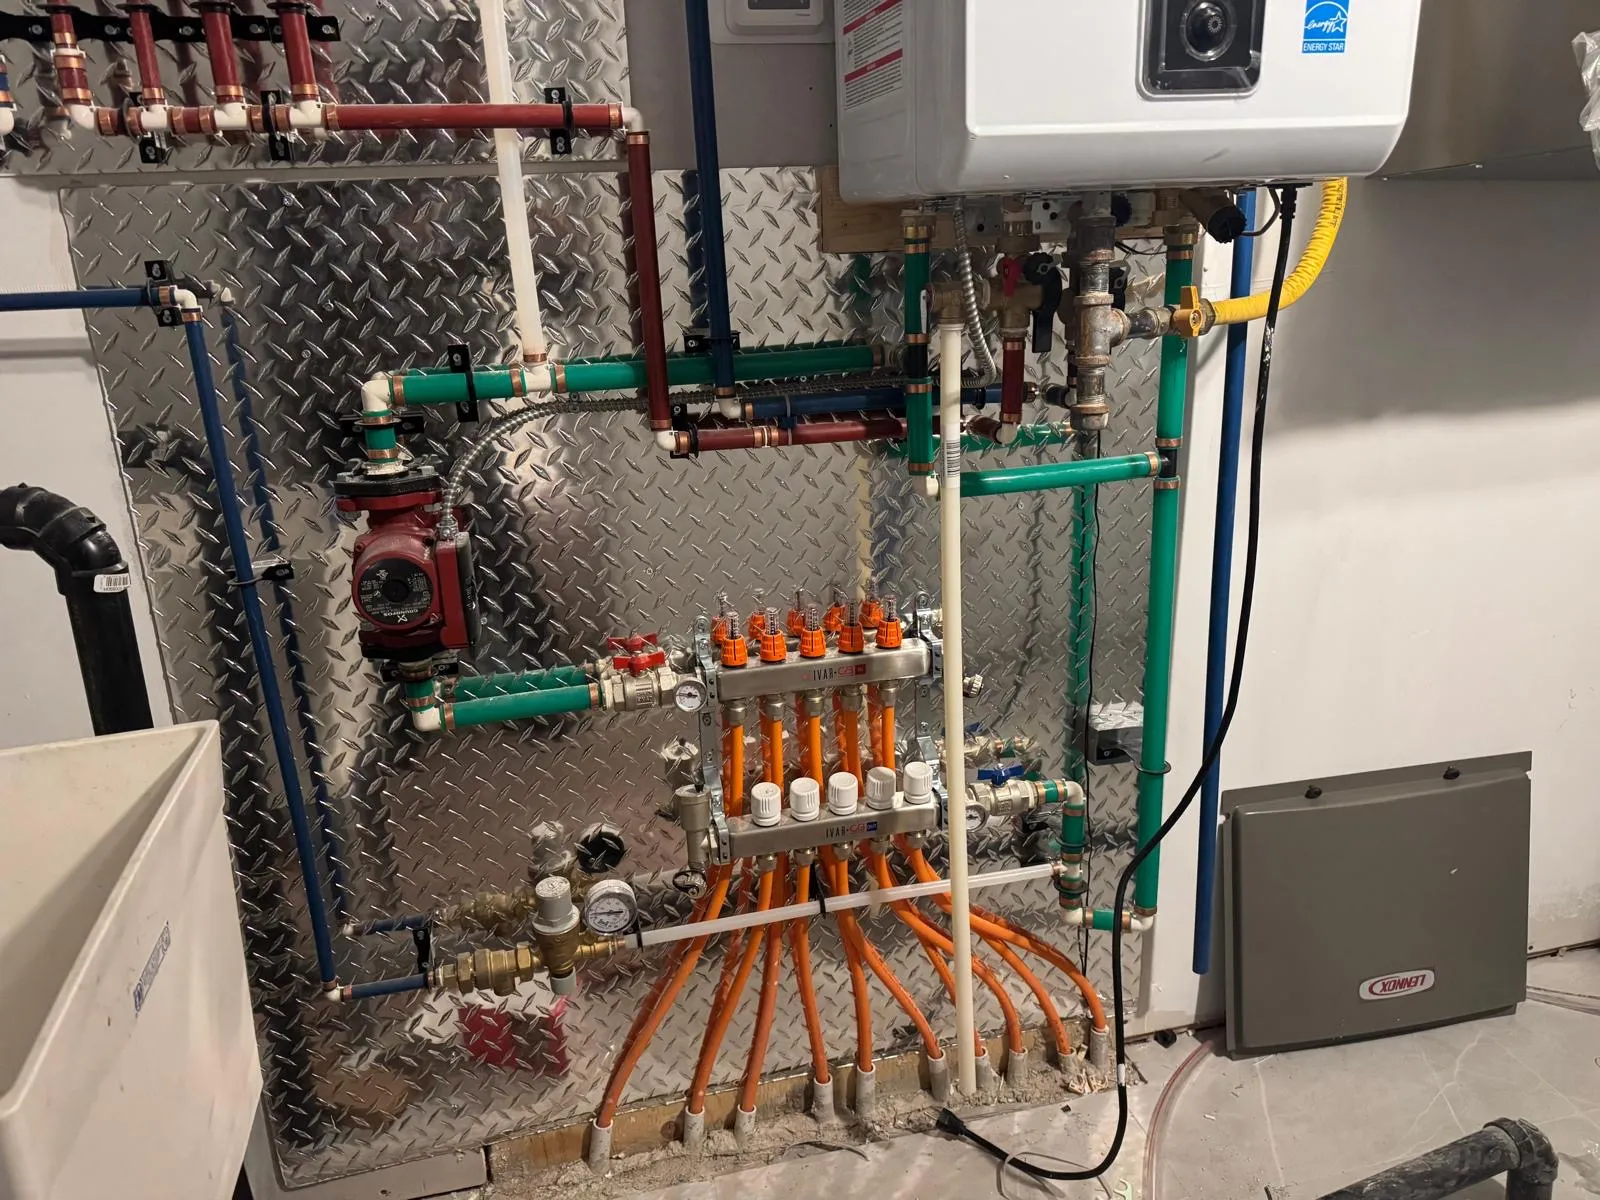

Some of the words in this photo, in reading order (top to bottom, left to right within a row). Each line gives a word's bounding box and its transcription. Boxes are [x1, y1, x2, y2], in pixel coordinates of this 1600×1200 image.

[1304, 42, 1327, 51] ENERGY
[1328, 42, 1344, 51] STAR
[1379, 974, 1427, 993] LENNOX
